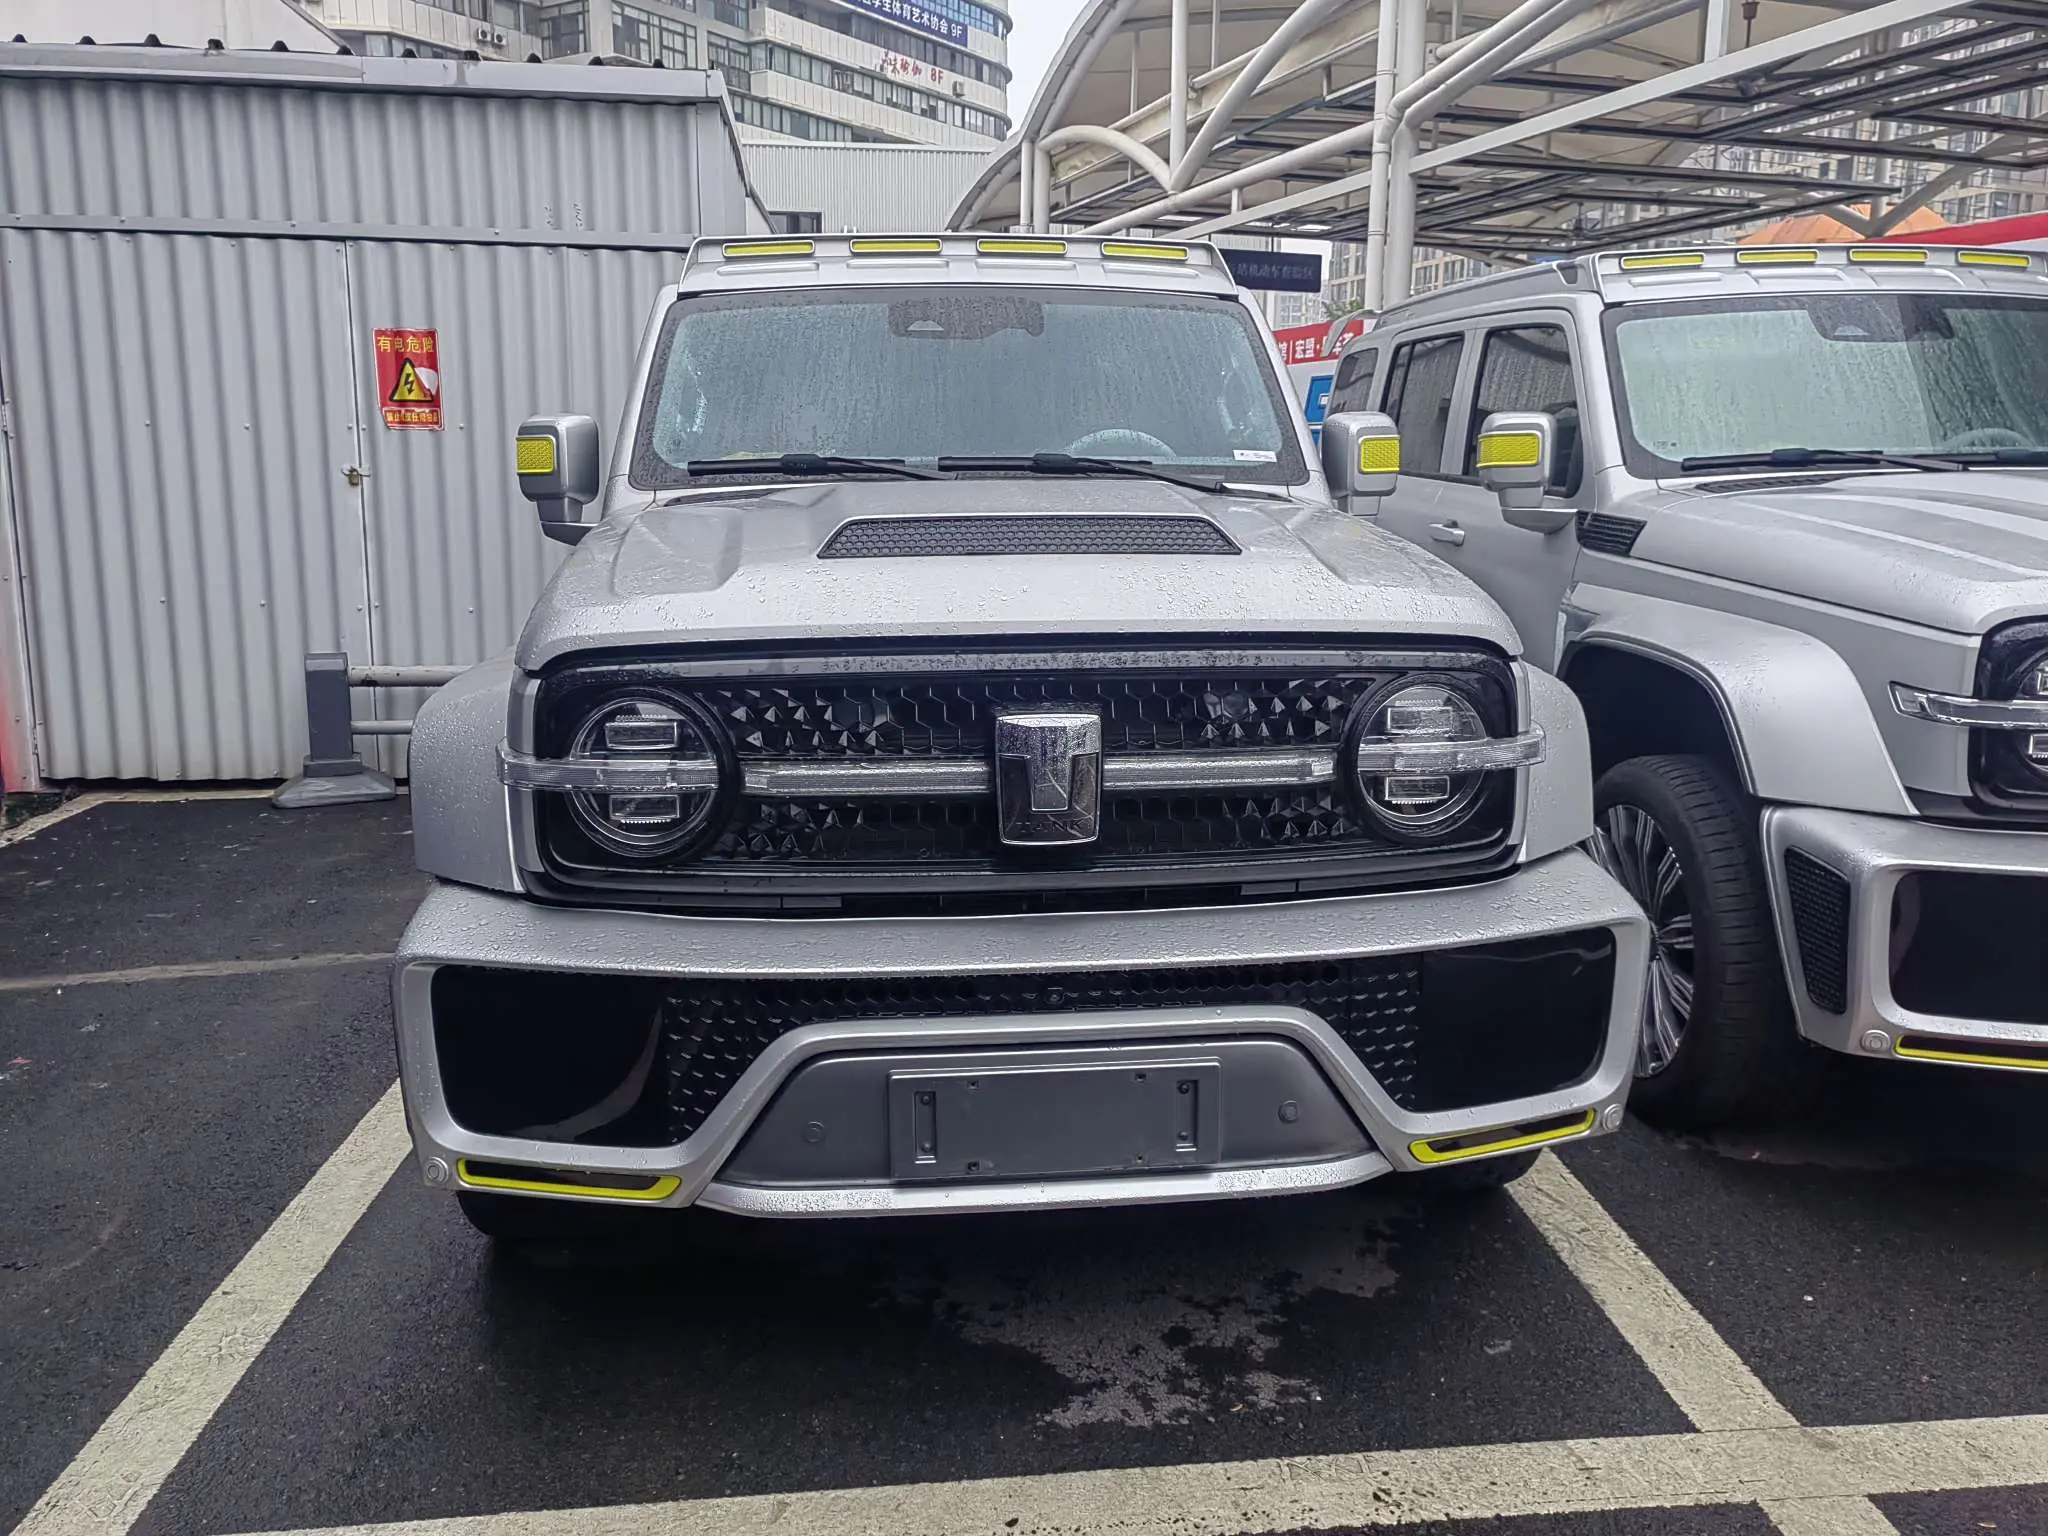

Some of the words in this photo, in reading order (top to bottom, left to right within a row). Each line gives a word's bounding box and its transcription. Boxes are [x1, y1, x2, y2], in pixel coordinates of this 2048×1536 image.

[950, 24, 963, 38] 9F
[930, 67, 944, 85] 8F
[376, 335, 435, 353] 有电危险
[1015, 820, 1083, 833] TANK
